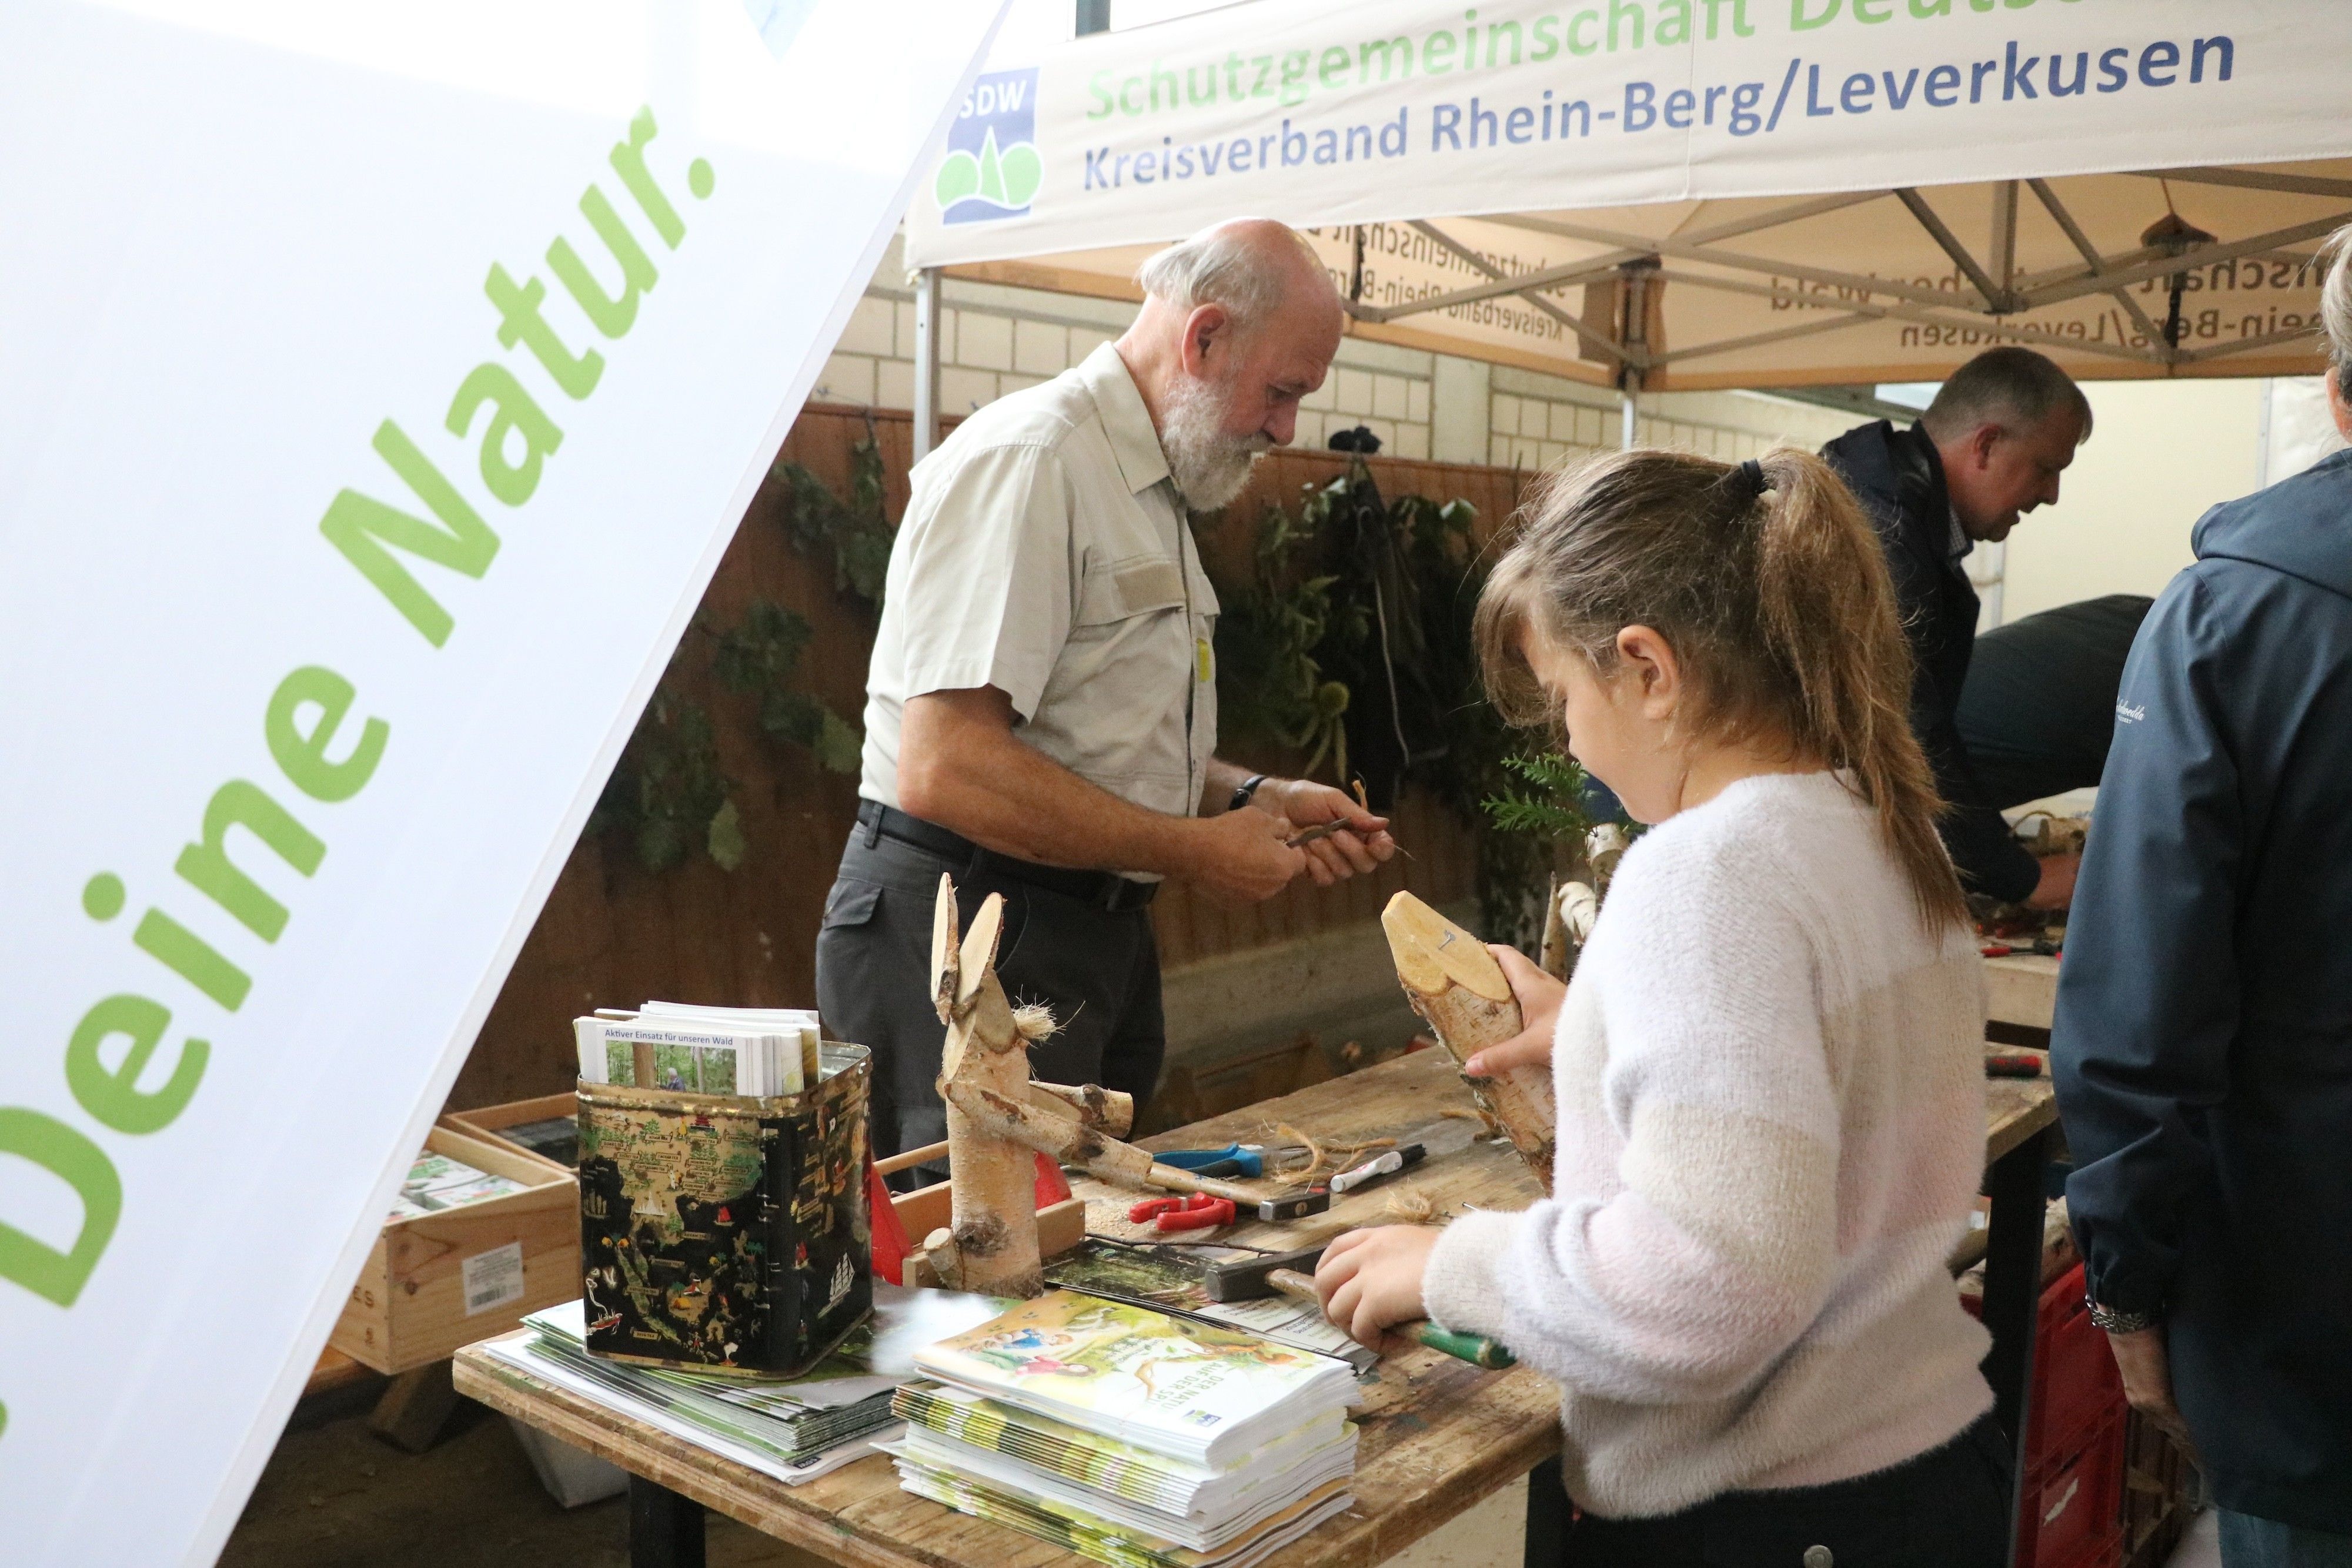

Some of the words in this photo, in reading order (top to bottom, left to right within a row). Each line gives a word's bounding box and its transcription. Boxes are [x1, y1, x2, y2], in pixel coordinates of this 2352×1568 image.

[959, 80, 1027, 119] SDW
[1084, 108, 1407, 191] Kreisverband
[1431, 36, 2234, 151] Rhein-Berg/Leverkusen
[0, 666, 389, 1309] Deine
[320, 105, 715, 648] Natur.
[605, 1029, 633, 1039] Aktiver
[636, 1031, 663, 1041] Einsatz
[665, 1033, 677, 1042] für
[679, 1035, 710, 1045] unseren
[713, 1037, 733, 1046] Wald
[1168, 1375, 1200, 1390] DER
[1195, 1375, 1224, 1390] DER
